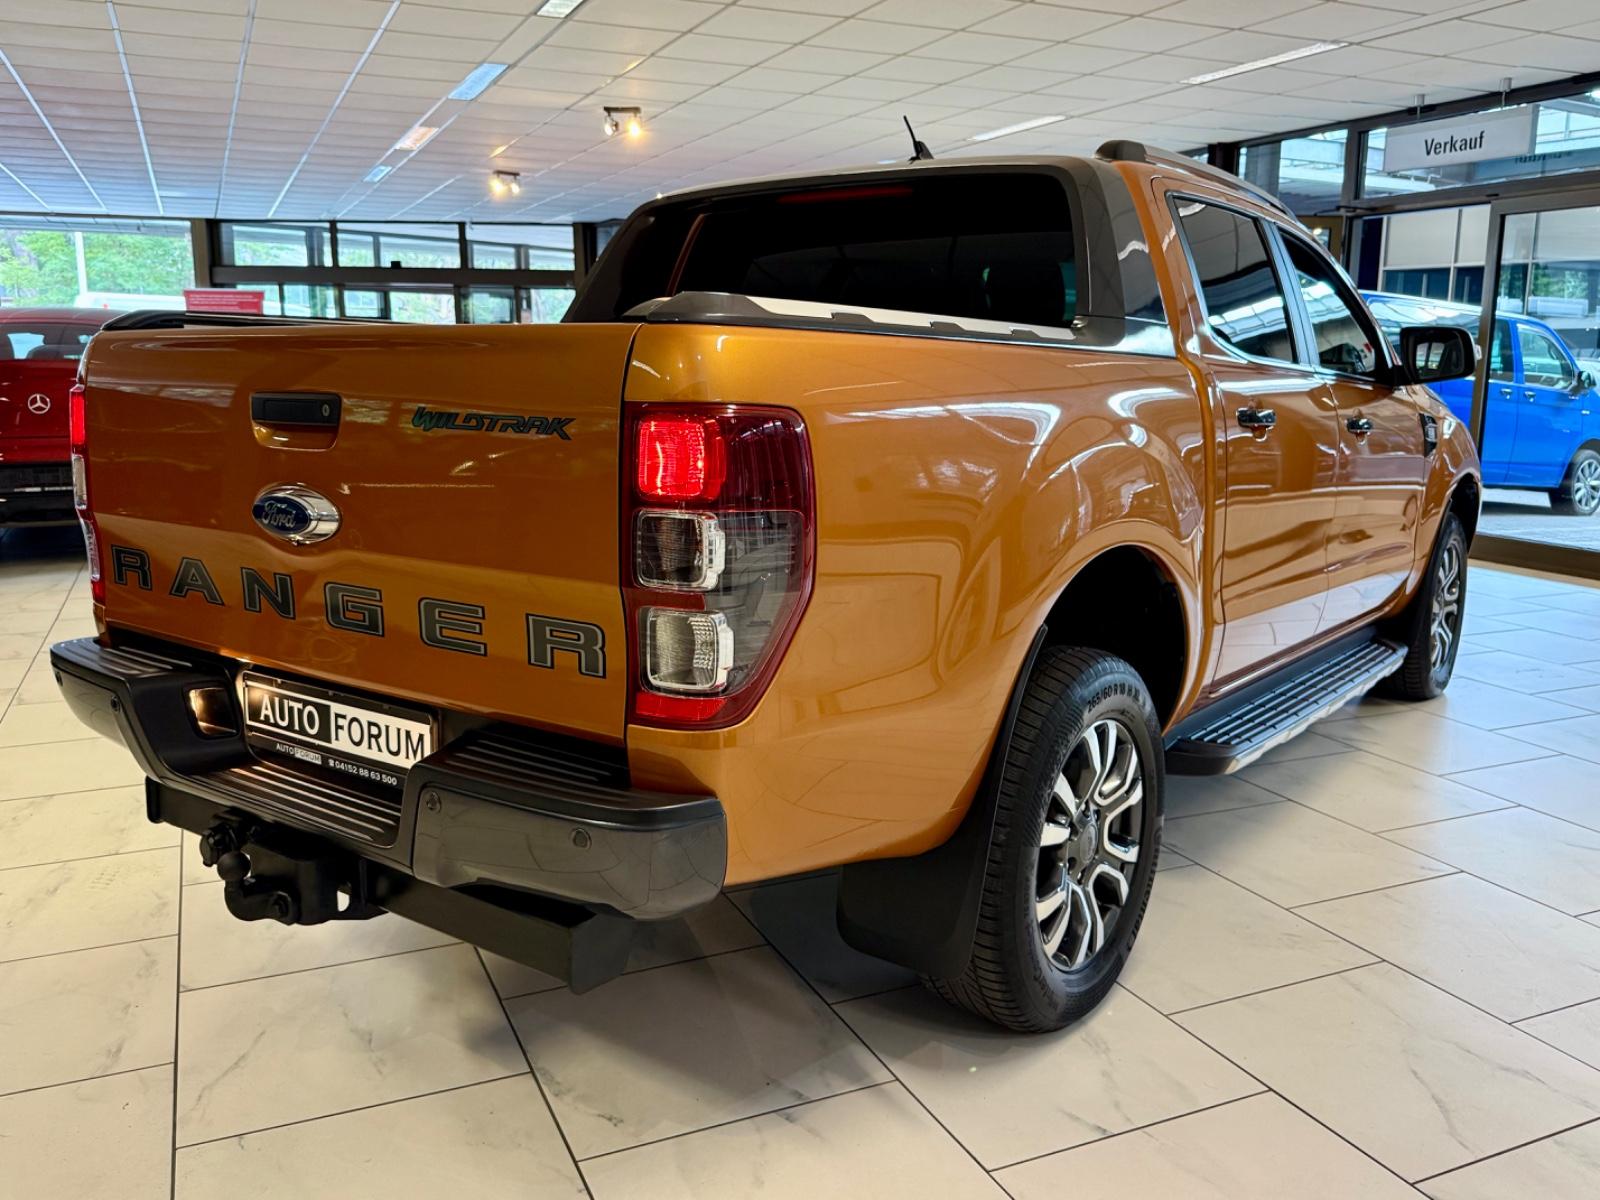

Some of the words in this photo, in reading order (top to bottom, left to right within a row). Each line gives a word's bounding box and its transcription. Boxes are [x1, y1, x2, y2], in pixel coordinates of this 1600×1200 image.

[1424, 130, 1485, 157] Verkauf
[410, 406, 576, 441] WILDTRAK
[261, 501, 297, 530] Ford
[110, 543, 607, 679] RANGER
[259, 693, 320, 736] AUTO
[334, 711, 425, 761] FORUM
[382, 774, 398, 786] 500
